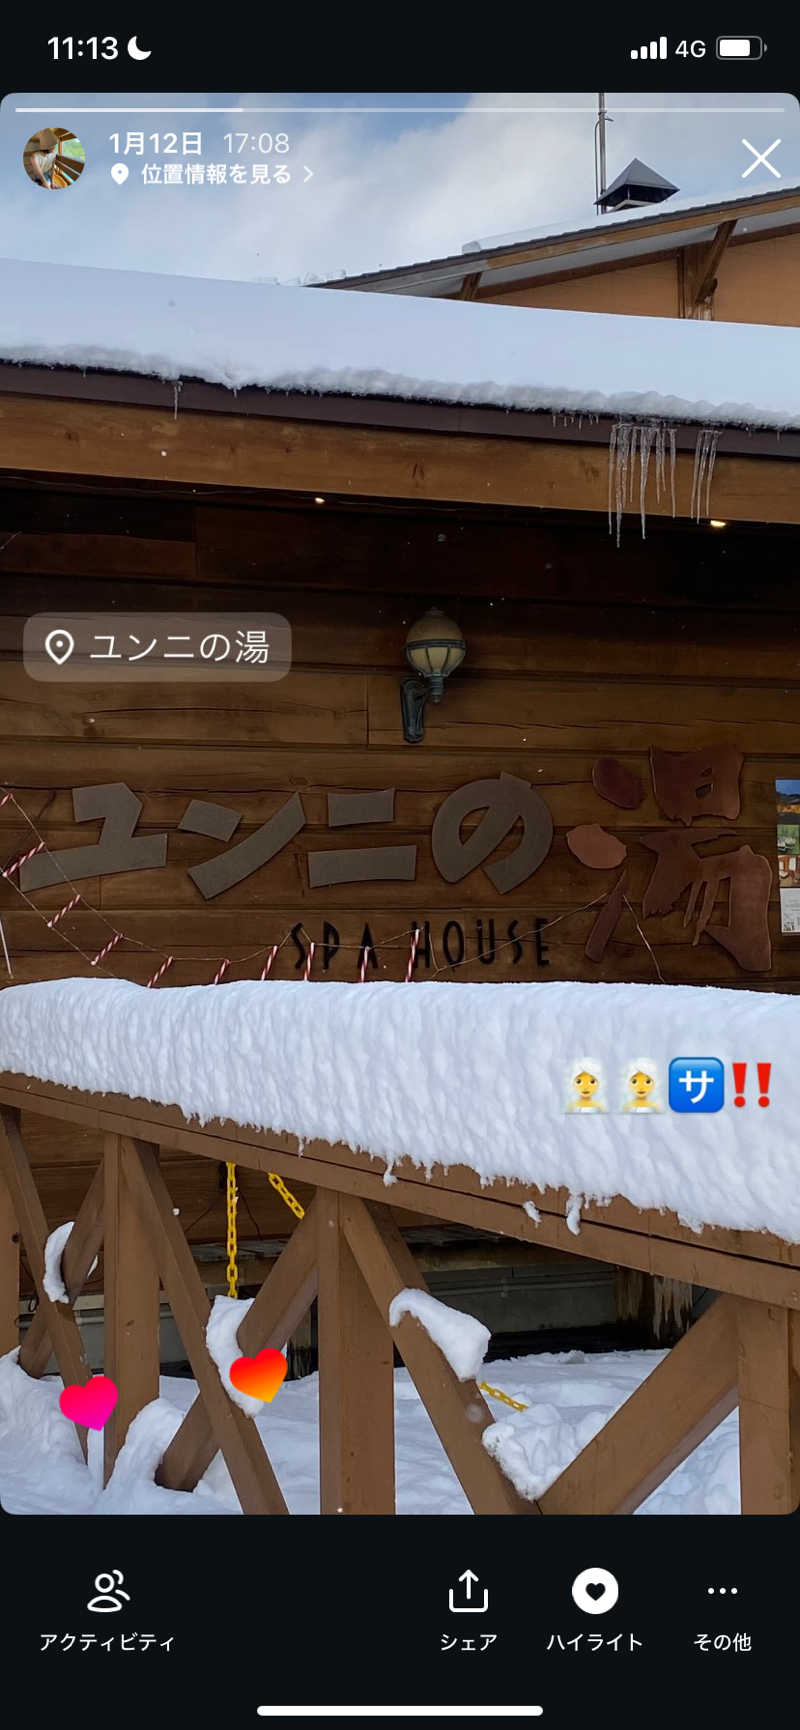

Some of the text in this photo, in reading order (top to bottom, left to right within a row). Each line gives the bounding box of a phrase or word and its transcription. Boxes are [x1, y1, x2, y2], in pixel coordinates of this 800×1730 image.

[19, 744, 772, 973] ユンニの湯
[290, 917, 551, 970] SPA HOUSE
